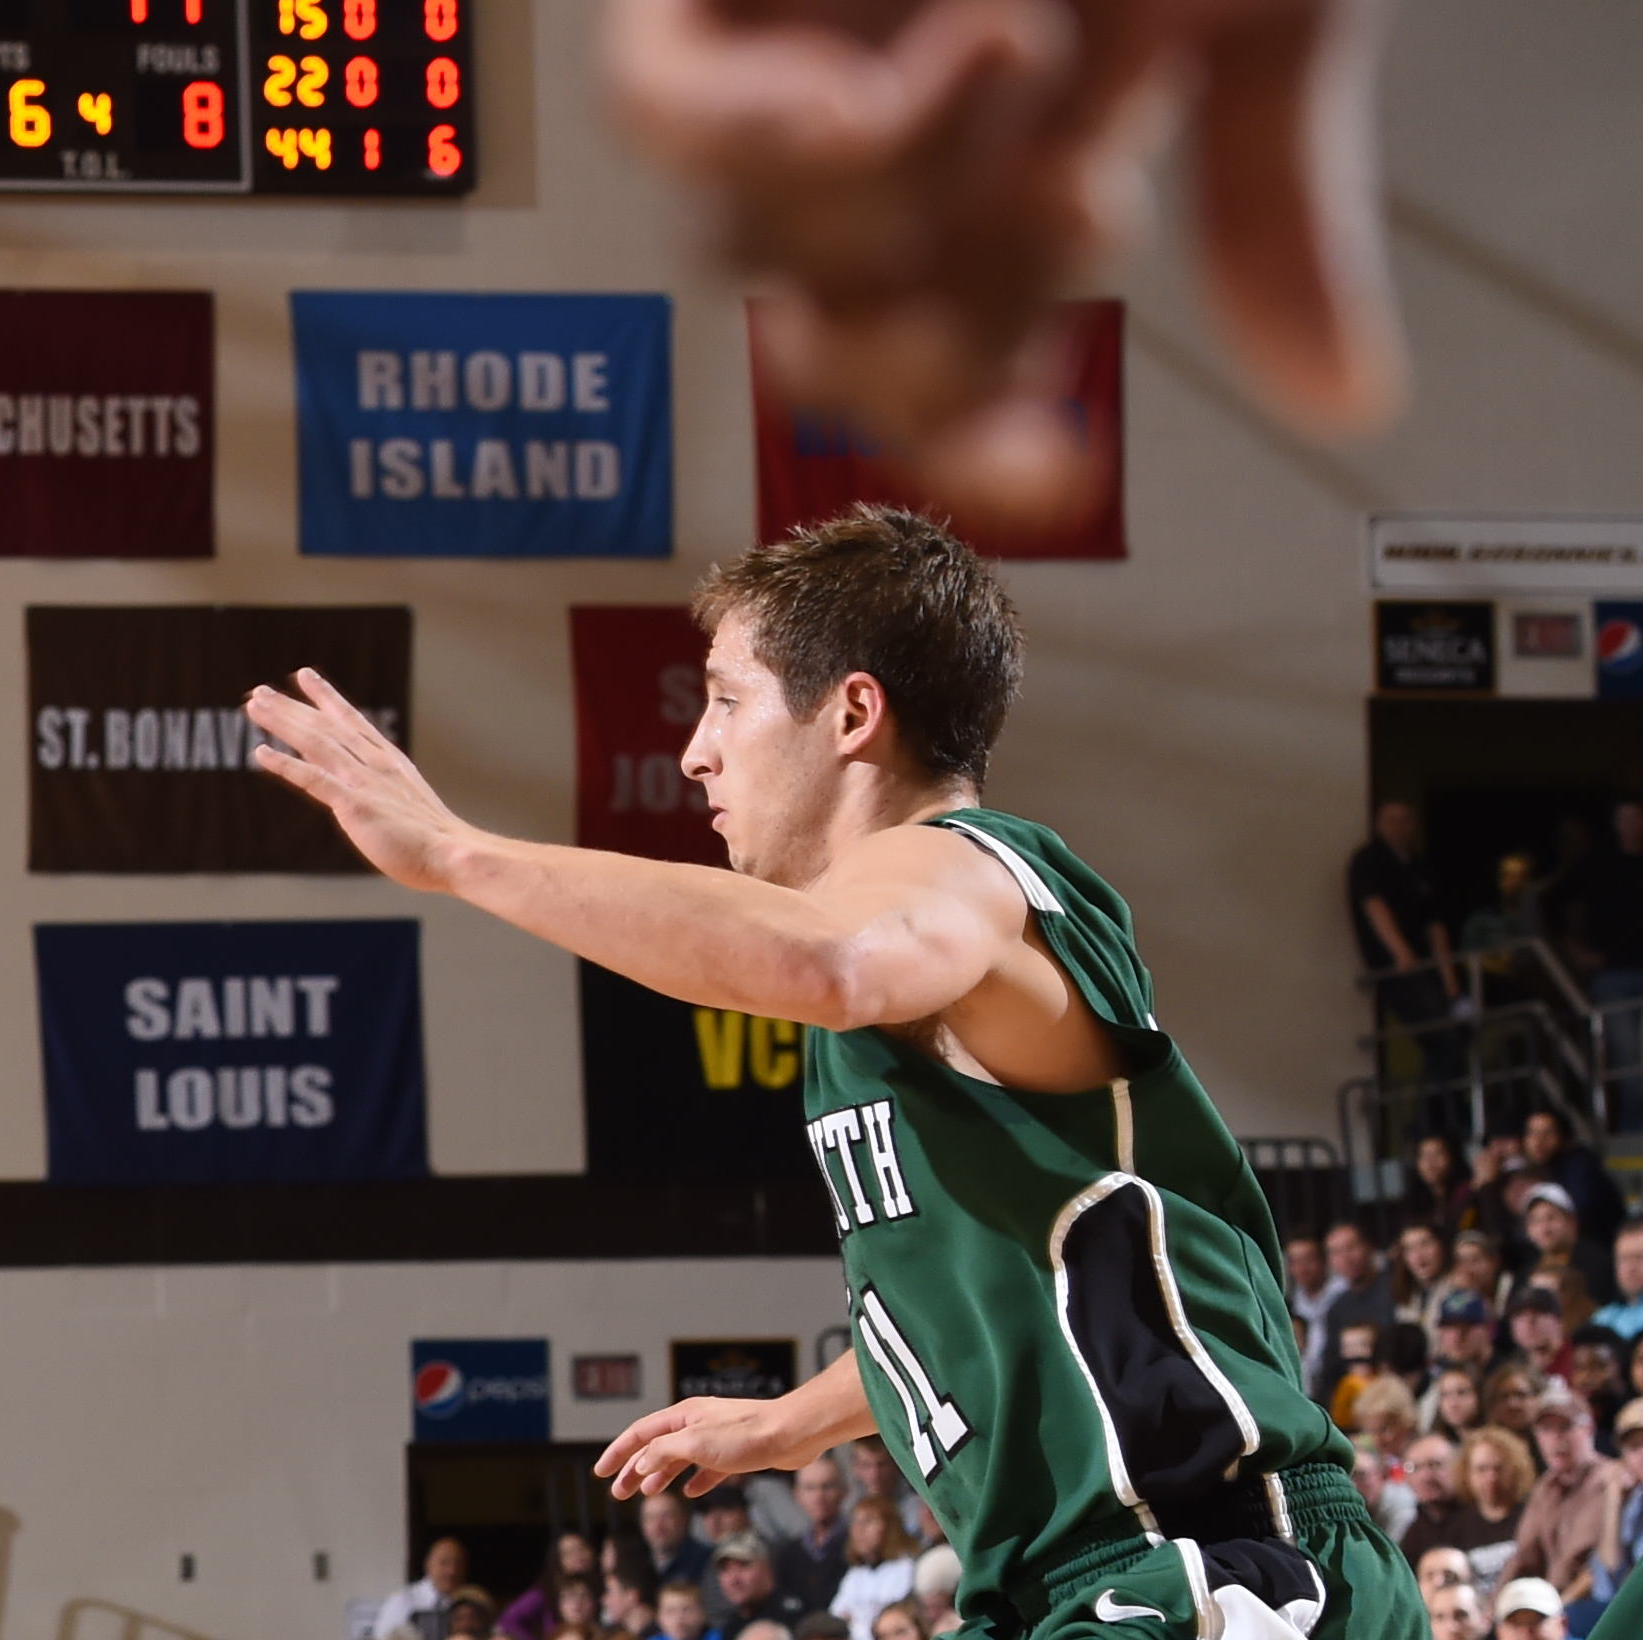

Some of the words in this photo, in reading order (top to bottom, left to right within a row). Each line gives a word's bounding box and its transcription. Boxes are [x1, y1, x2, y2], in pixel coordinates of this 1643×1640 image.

[278, 0, 328, 40] 15
[344, 0, 377, 40] 0
[424, 0, 458, 41] 0
[135, 44, 220, 74] FOULS
[264, 55, 329, 107] 22
[346, 56, 378, 107] 0
[426, 57, 459, 108] 0
[8, 79, 51, 148] 6
[77, 92, 112, 136] 4
[183, 81, 224, 148] 8
[266, 128, 331, 170] 44
[365, 128, 380, 170] 1
[428, 124, 462, 176] 6
[356, 350, 611, 412] RHODE
[348, 438, 621, 501] ISLAND
[37, 706, 100, 769] ST.
[126, 975, 339, 1041] SAINT
[693, 1006, 798, 1090] VC
[135, 1066, 335, 1131] LOUIS
